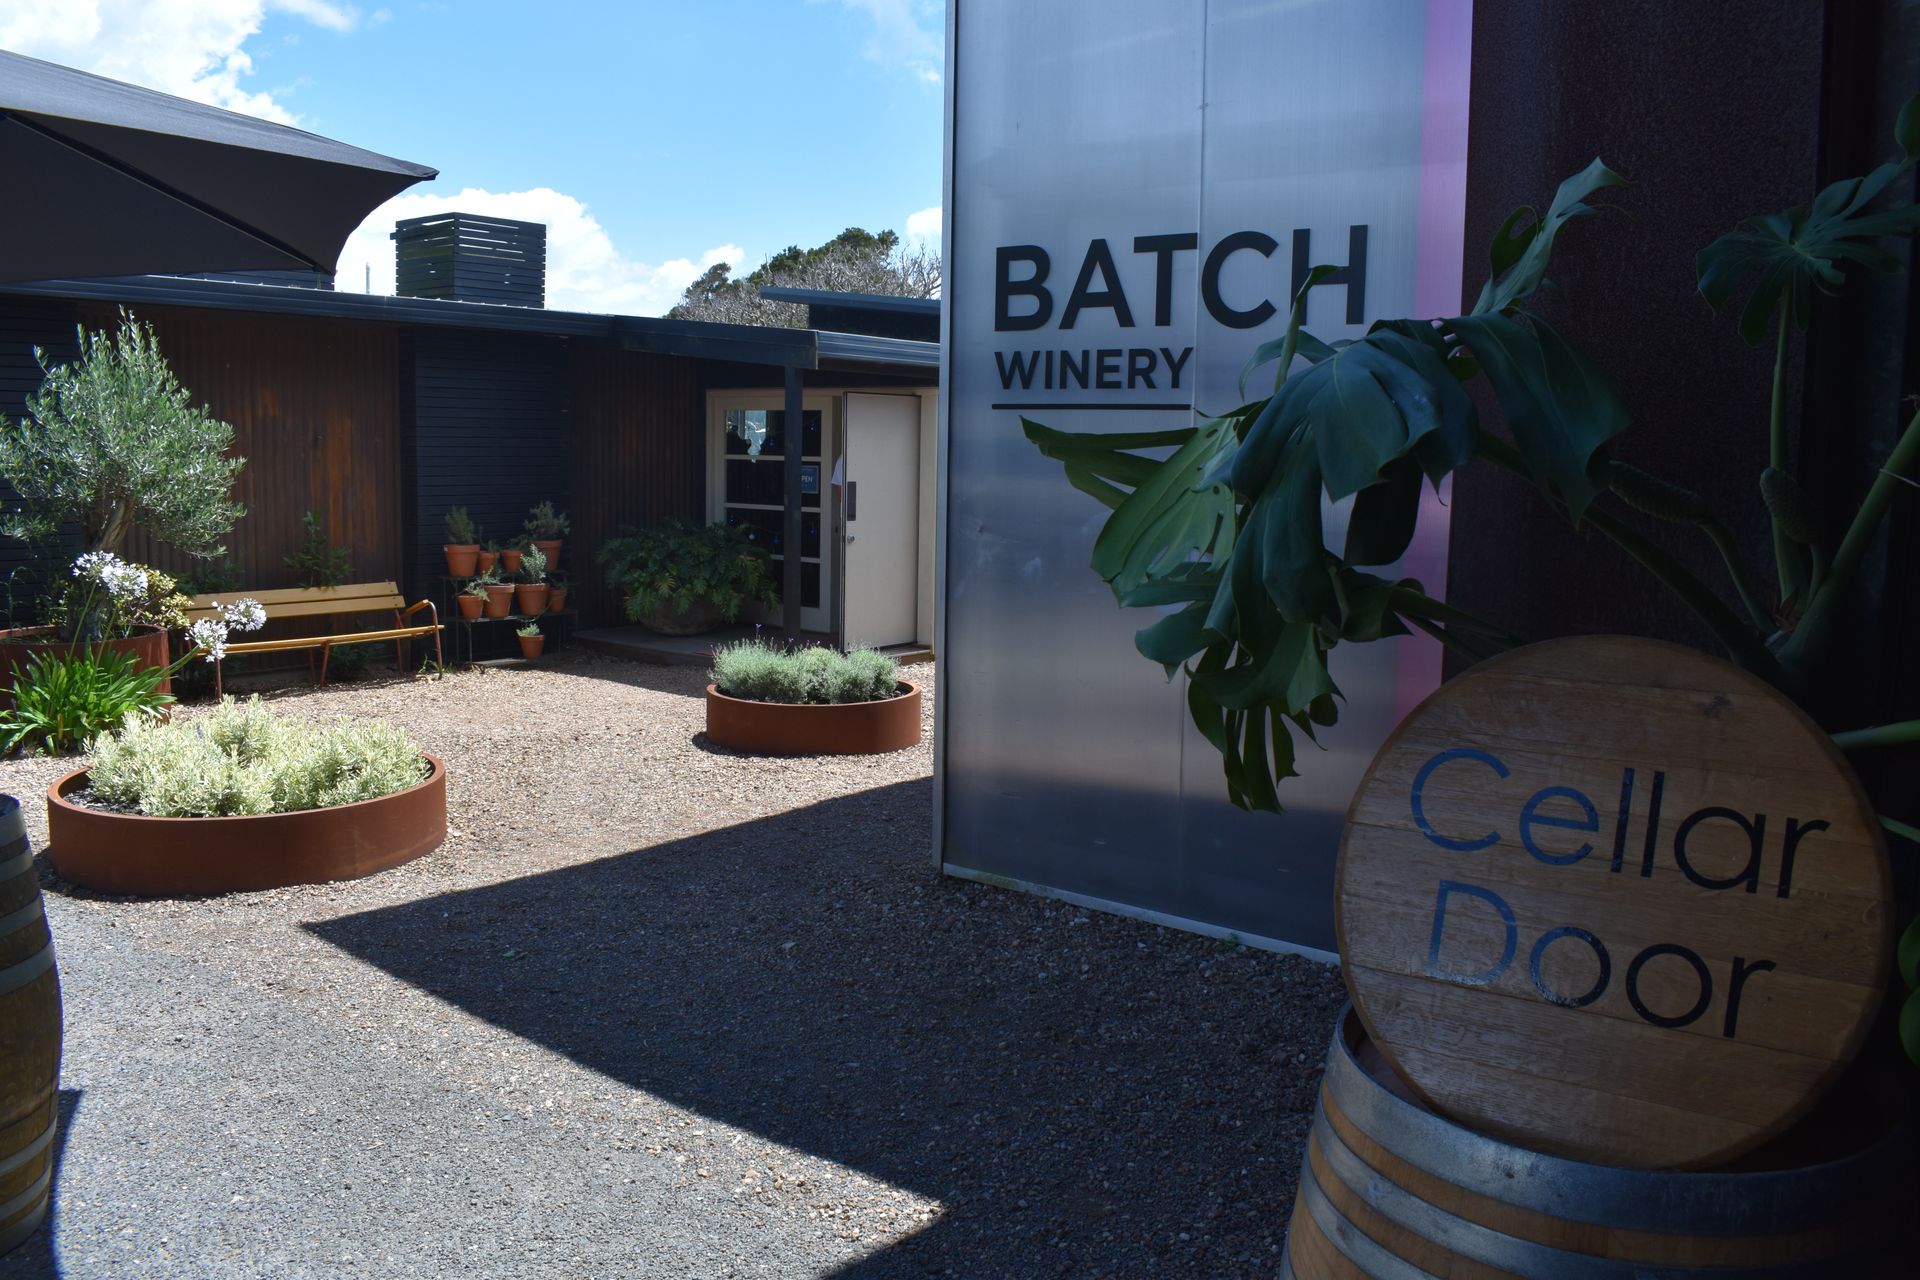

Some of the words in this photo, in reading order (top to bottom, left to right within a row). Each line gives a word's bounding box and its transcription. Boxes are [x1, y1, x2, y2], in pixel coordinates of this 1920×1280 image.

[994, 224, 1369, 332] BATCH
[995, 346, 1194, 390] WINERY
[800, 475, 813, 483] PEN
[1411, 748, 1831, 899] Cellar
[1425, 879, 1777, 1039] Door
